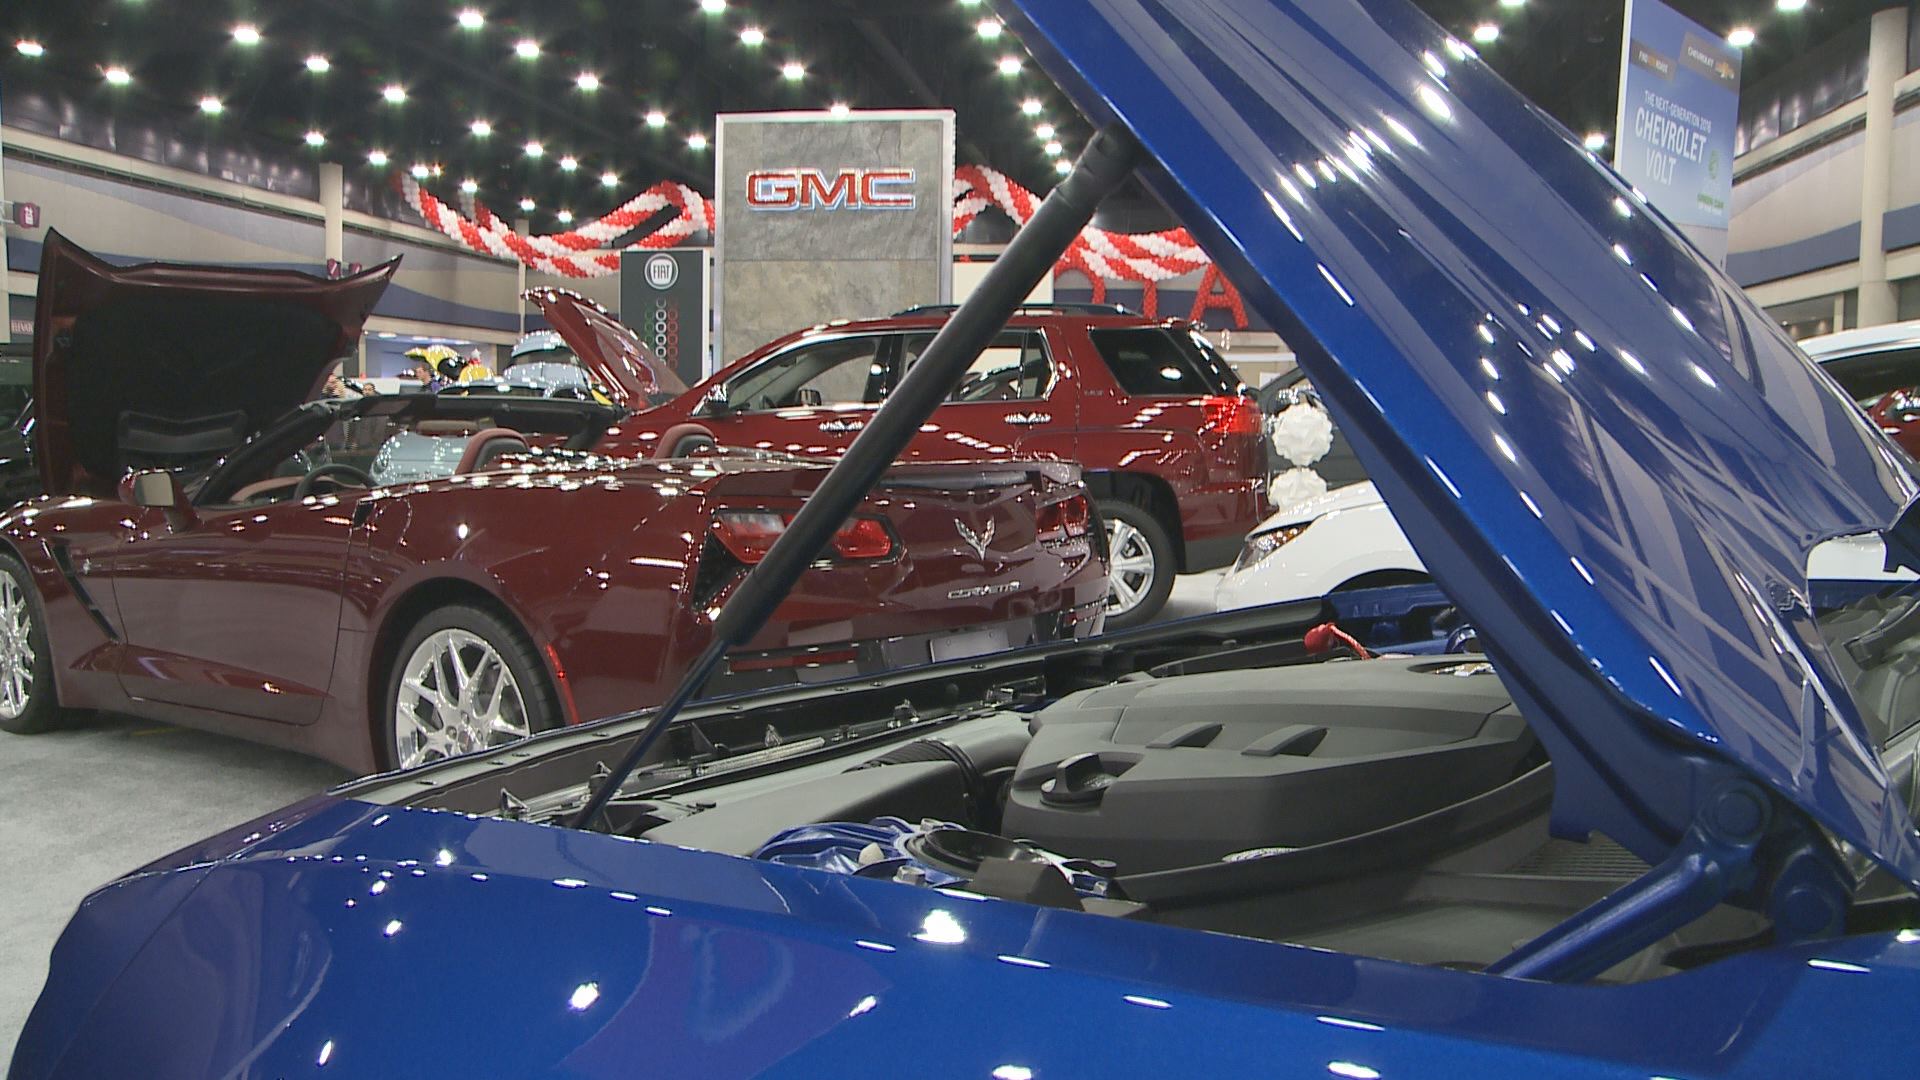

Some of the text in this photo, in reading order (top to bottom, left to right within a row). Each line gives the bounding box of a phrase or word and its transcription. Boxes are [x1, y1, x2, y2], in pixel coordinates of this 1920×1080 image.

[1687, 46, 1714, 68] CHEVROLET
[1644, 90, 1655, 107] THE
[1635, 107, 1707, 164] CHEVROLET
[1646, 148, 1676, 187] VOLT
[746, 168, 915, 212] GMC
[653, 264, 670, 279] FIAT
